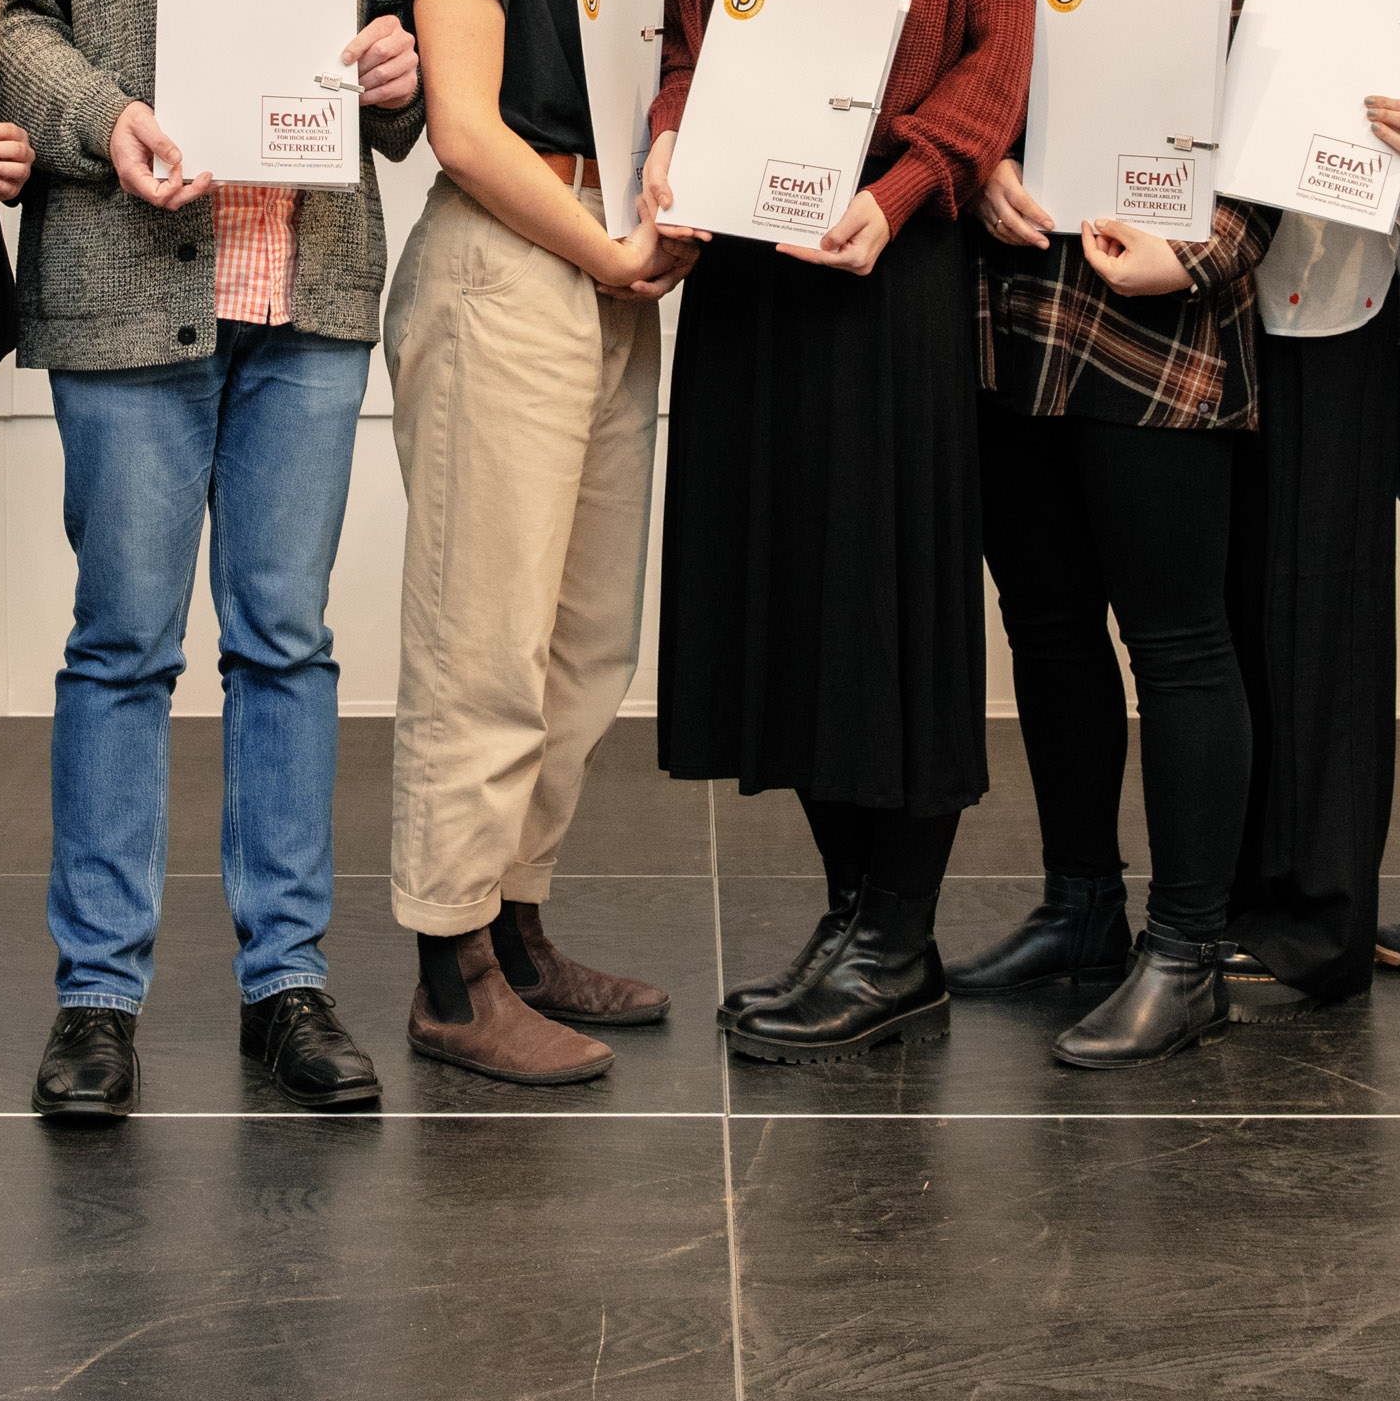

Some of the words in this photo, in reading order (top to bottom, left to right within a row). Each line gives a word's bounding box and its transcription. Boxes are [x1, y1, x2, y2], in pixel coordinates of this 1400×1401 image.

[269, 112, 321, 128] ECHA
[268, 141, 336, 153] ÖSTERREICH
[1315, 150, 1365, 175] ECHA
[768, 175, 816, 195] ECHA
[1125, 171, 1174, 187] ECHA
[1308, 176, 1375, 200] ÖSTERREICH
[762, 202, 825, 220] ÖSTERREICH
[1123, 198, 1187, 211] ÖSTERREICH
